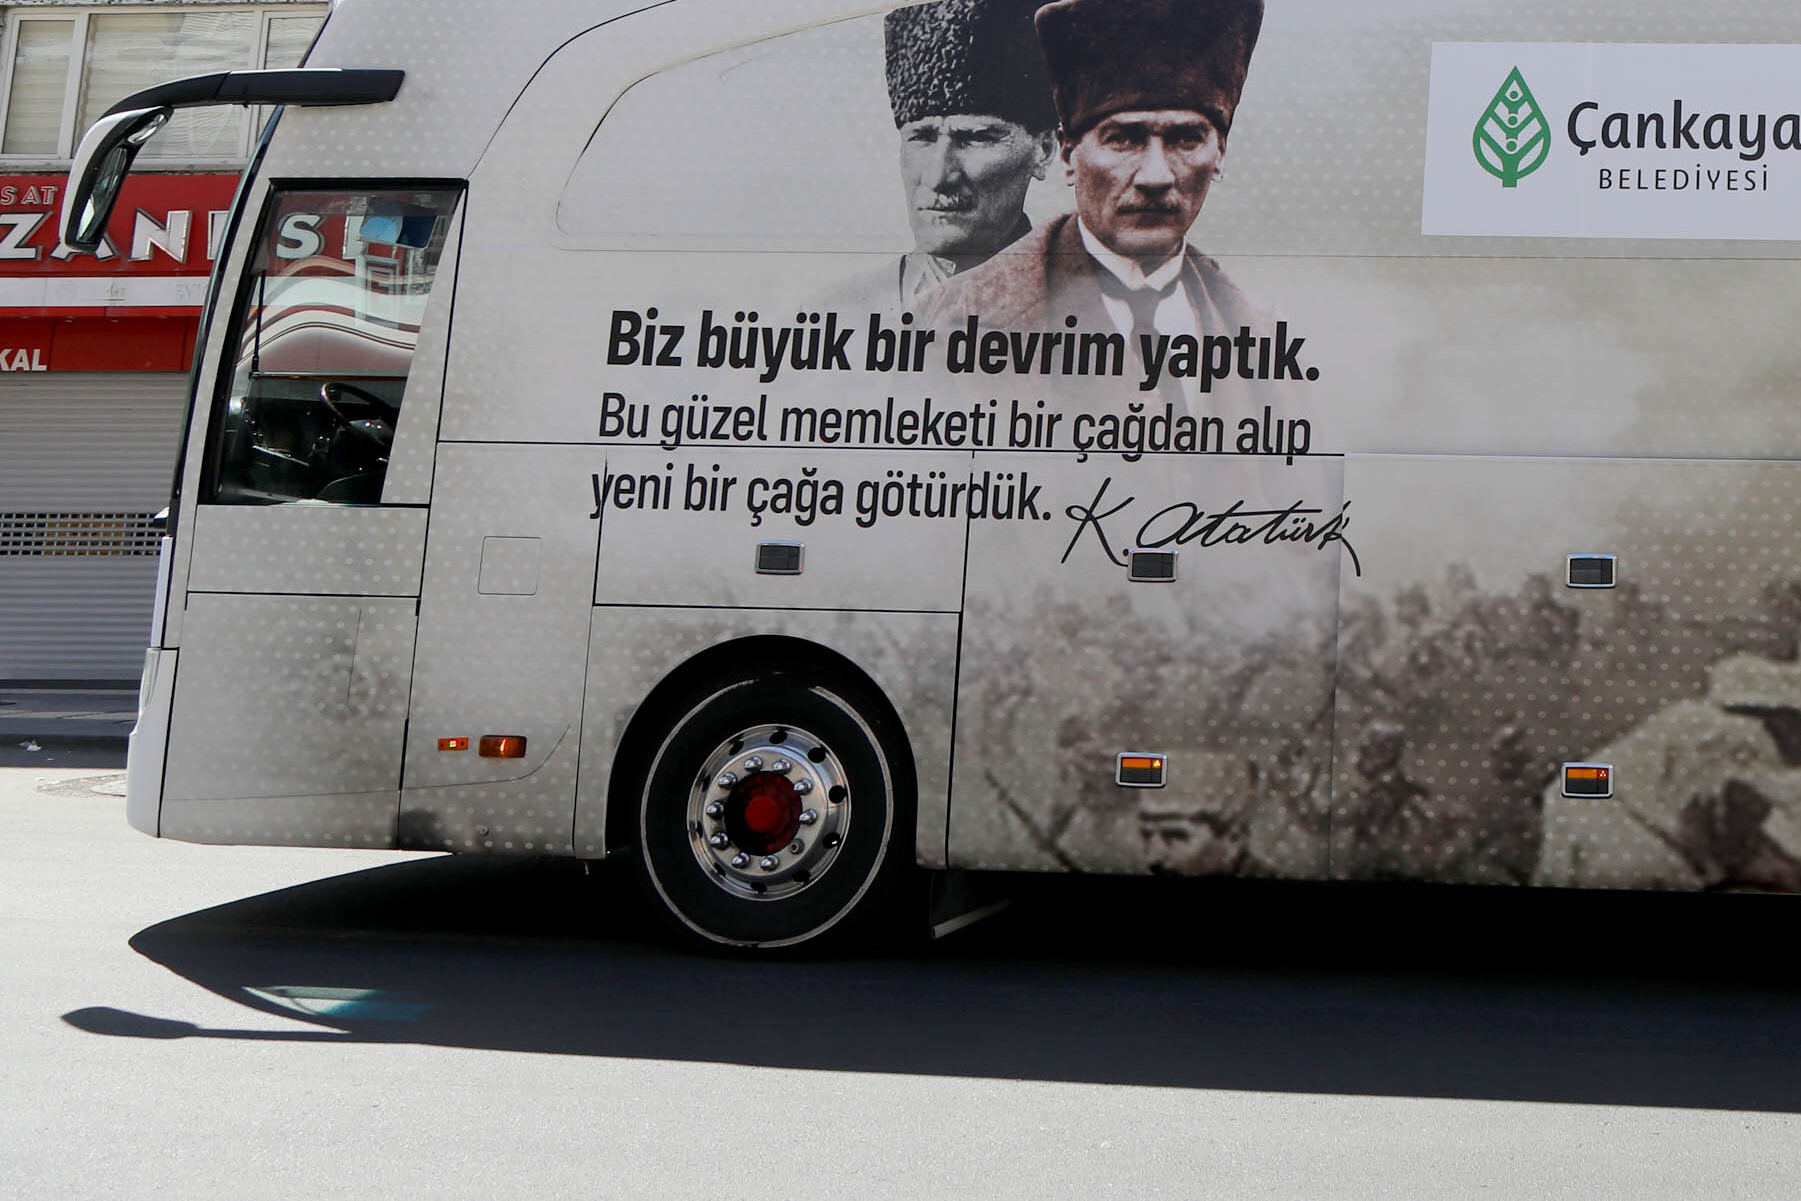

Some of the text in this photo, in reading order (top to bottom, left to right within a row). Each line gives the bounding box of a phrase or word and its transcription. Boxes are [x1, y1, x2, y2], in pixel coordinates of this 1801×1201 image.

[1599, 163, 1768, 191] BELEDİYESİ
[607, 307, 1320, 393] Biz büyük bir devrim yaptık.
[599, 392, 1312, 465] Bu güzel memleketi bir çağdan alıp
[589, 462, 1052, 528] yeni bir çağa götürdük.
